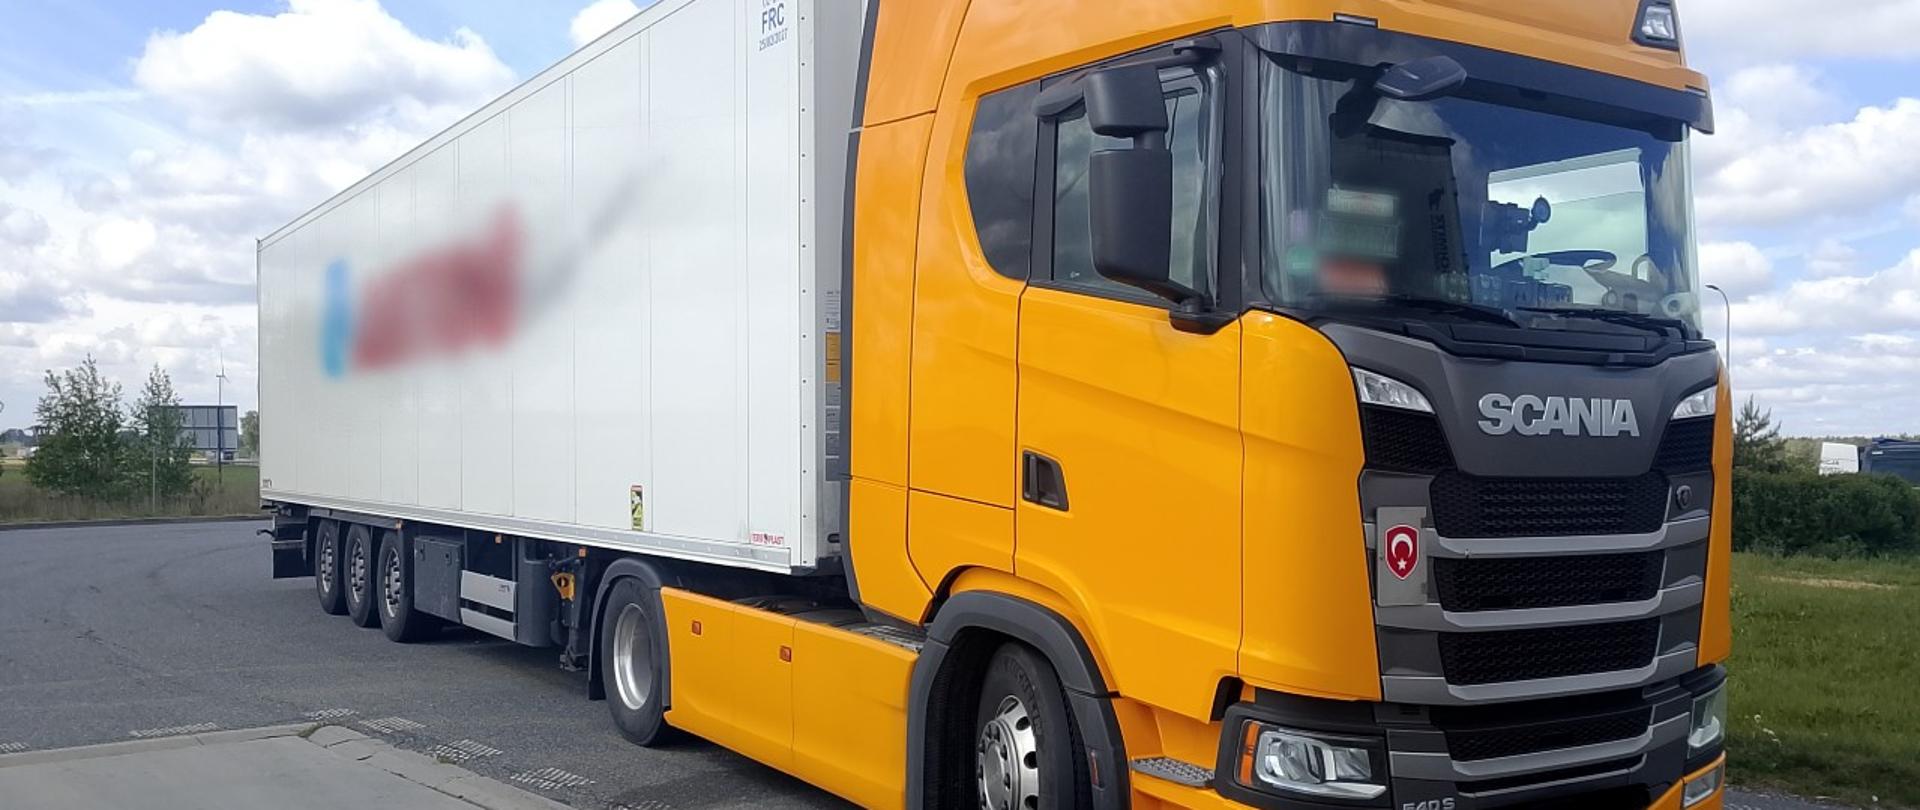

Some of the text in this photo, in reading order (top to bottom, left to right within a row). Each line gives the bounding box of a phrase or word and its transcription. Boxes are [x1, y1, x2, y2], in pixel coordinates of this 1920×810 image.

[761, 2, 785, 35] FRC
[1478, 393, 1640, 437] SCANIA
[1442, 797, 1456, 810] S
